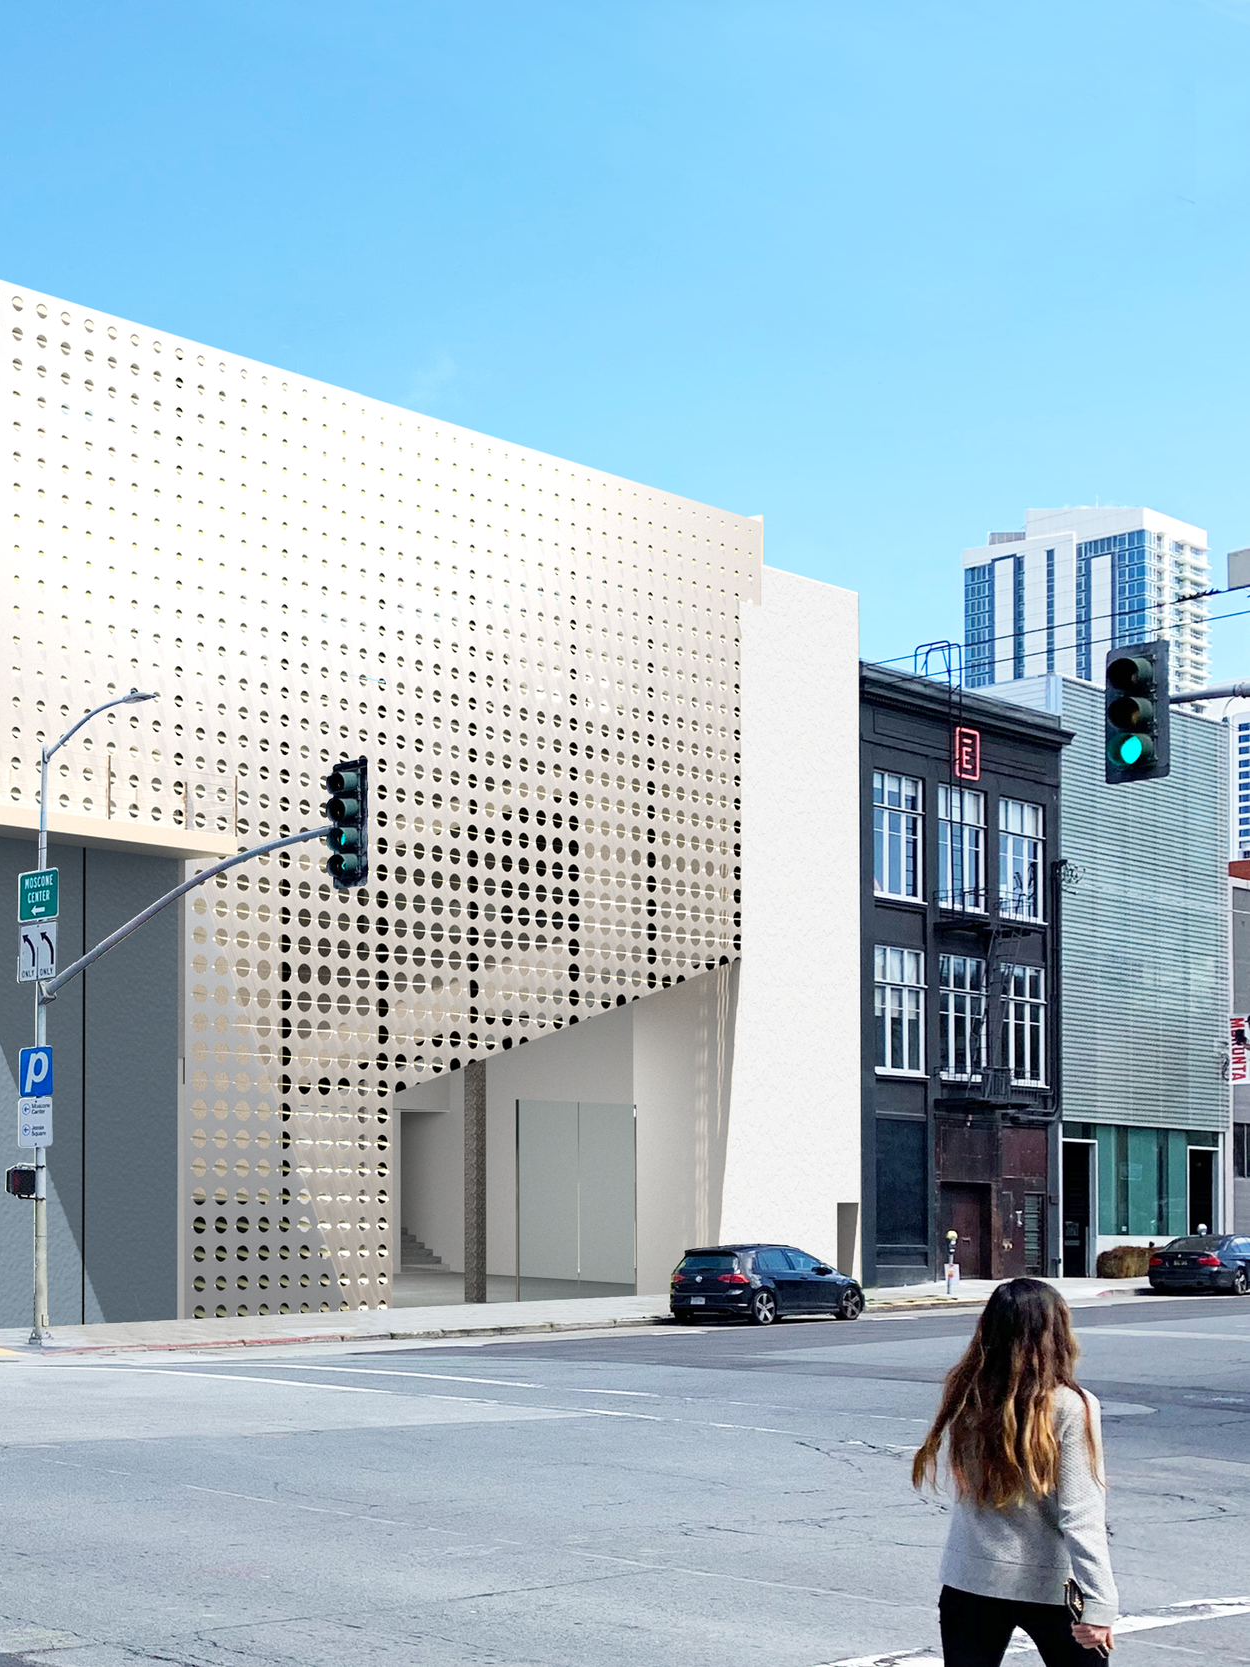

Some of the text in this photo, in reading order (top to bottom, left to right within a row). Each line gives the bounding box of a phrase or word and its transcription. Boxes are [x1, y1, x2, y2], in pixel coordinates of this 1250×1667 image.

[24, 874, 54, 889] MOSCONE
[27, 890, 51, 904] CENTER
[21, 970, 35, 979] ONLY
[39, 968, 53, 977] ONLY
